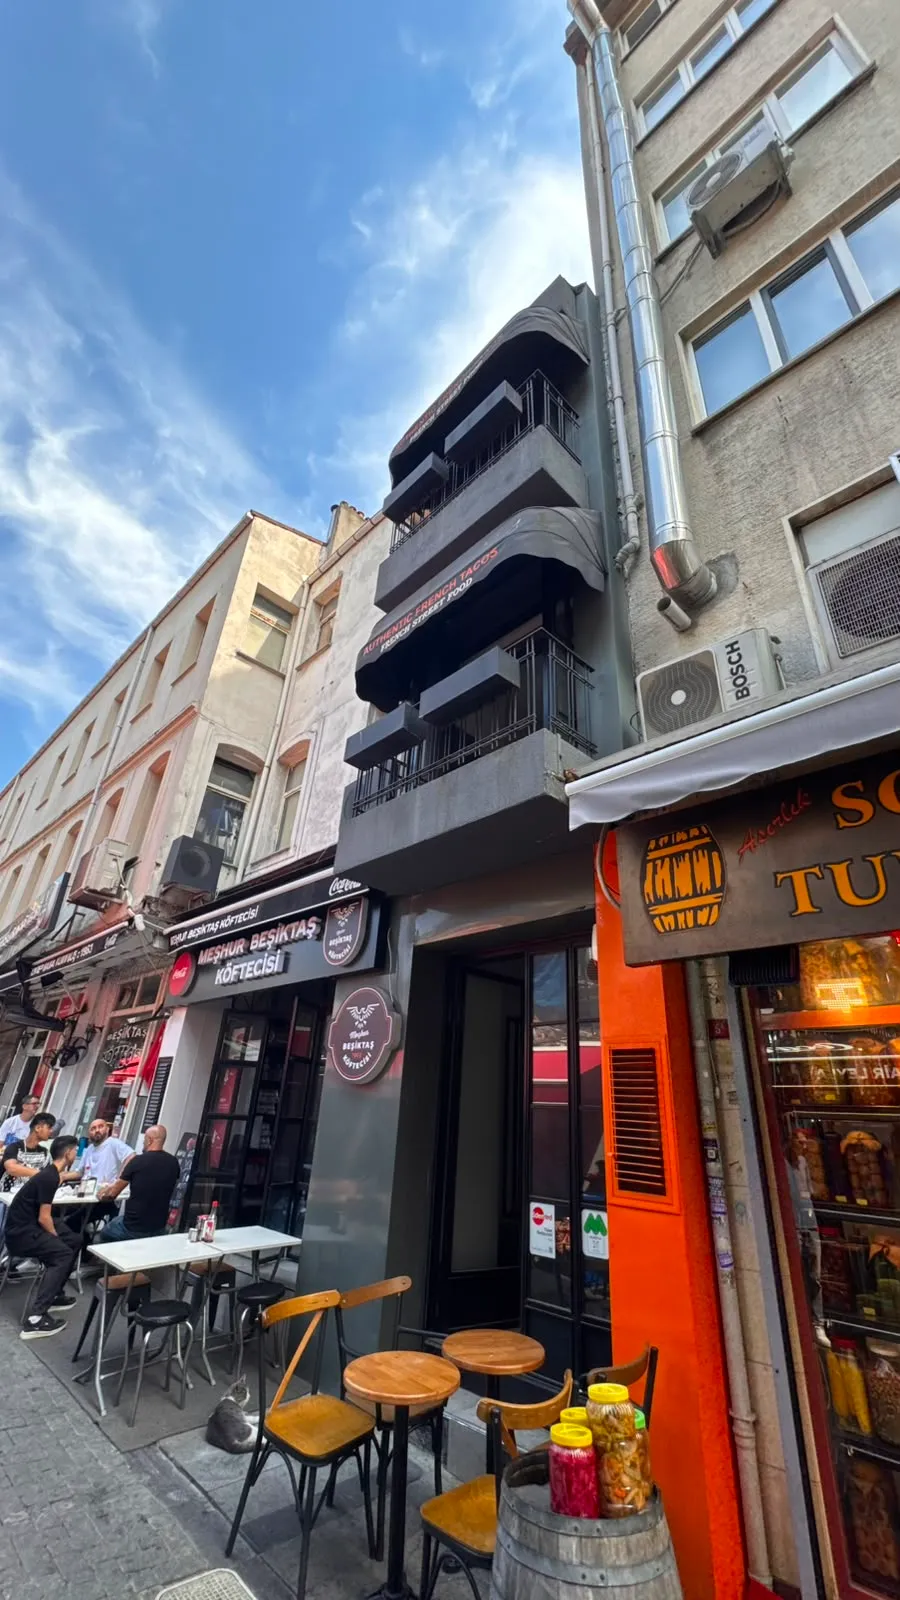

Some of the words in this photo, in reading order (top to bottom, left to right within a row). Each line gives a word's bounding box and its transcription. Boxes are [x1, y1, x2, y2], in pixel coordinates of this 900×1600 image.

[363, 612, 413, 655] AUTHENTIC
[415, 578, 457, 617] FRENCH
[459, 547, 499, 582] TACOS
[380, 622, 411, 653] FRENCH
[411, 597, 446, 629] STREET
[446, 577, 473, 602] FOOD
[725, 640, 750, 700] BOSCH
[775, 850, 900, 917] TU
[198, 938, 245, 965] MEŞHUR
[250, 917, 319, 950] BEŞİKTAŞ
[219, 905, 260, 929] KÖFTECİSİ
[215, 949, 282, 985] KÖFTECİSİ
[342, 1041, 374, 1051] BEŞİKTAŞ
